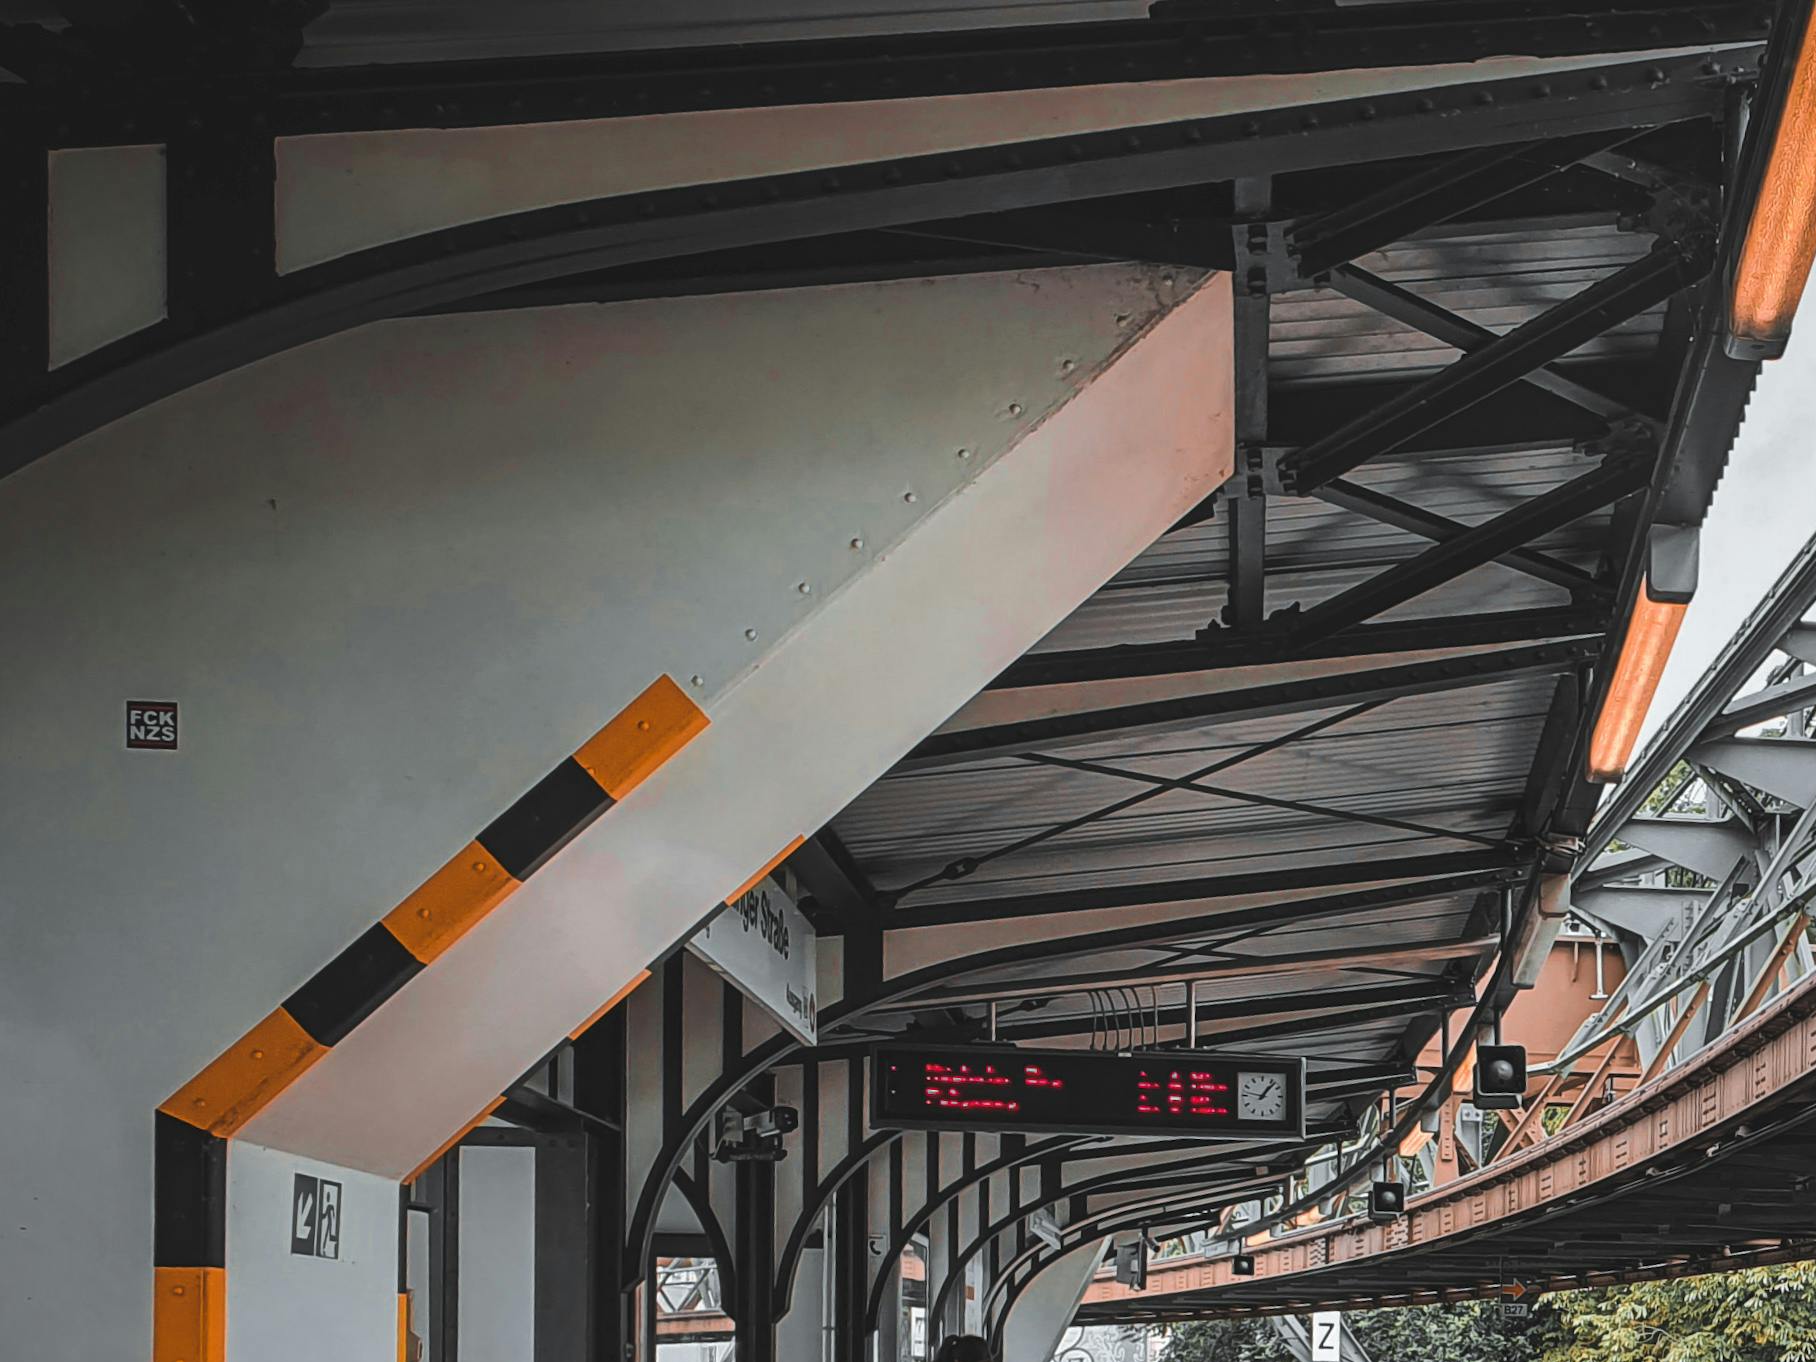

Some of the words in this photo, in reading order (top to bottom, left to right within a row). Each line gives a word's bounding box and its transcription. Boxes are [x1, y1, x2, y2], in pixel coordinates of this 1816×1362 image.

[130, 710, 175, 726] FCK
[130, 725, 175, 741] NZS
[732, 890, 759, 932] nger
[761, 890, 789, 960] Straße
[1504, 1305, 1524, 1315] B27
[1318, 1322, 1335, 1350] Z
